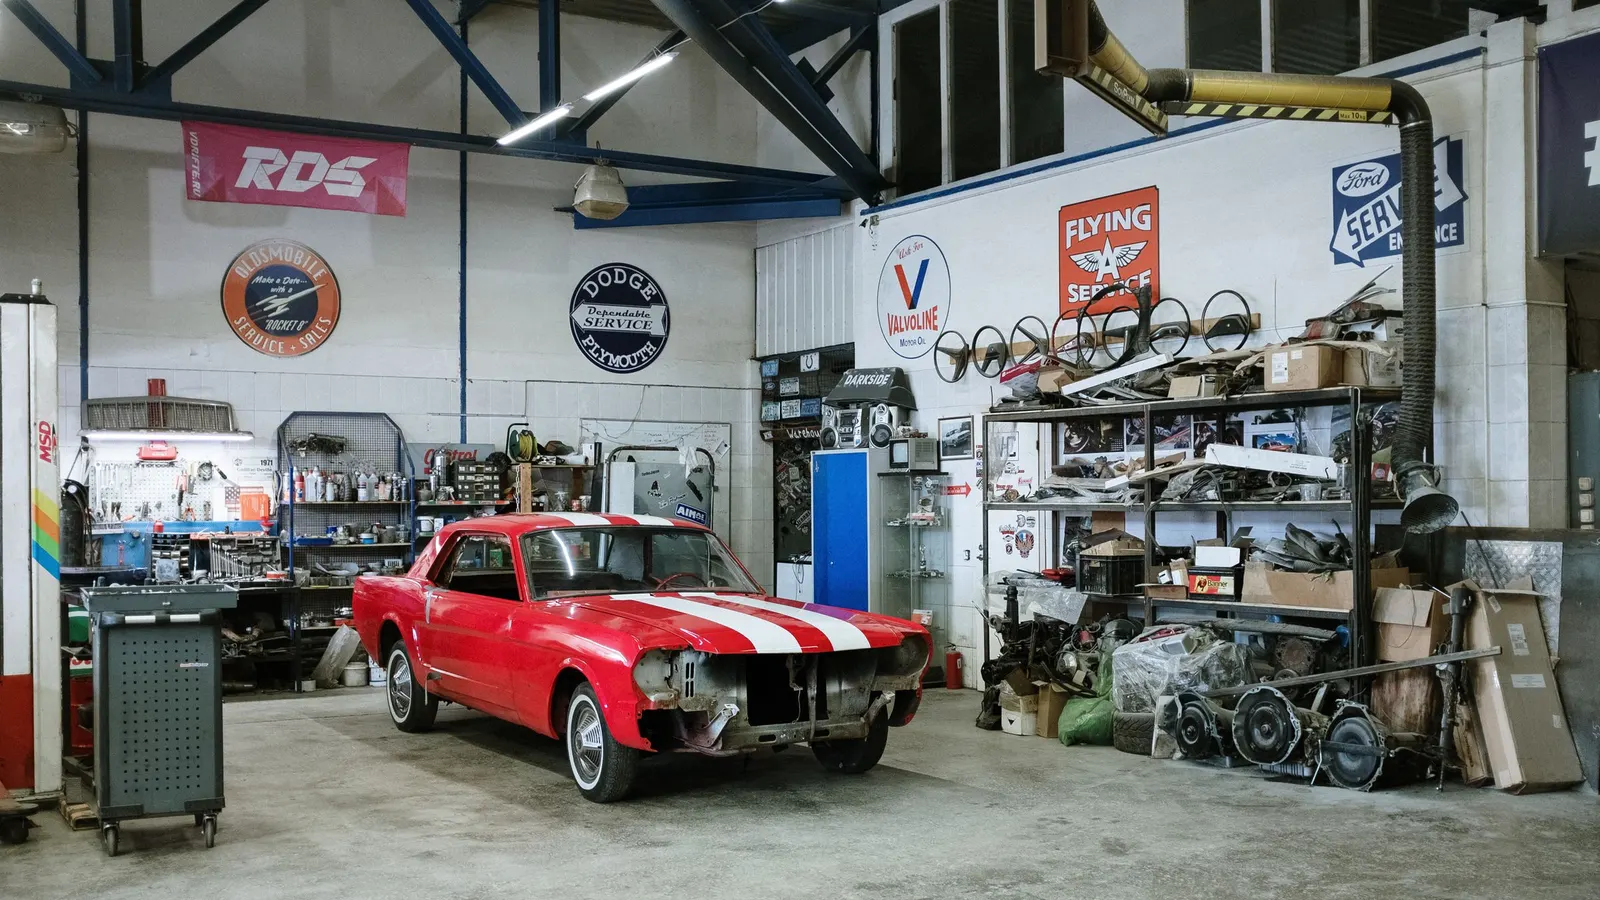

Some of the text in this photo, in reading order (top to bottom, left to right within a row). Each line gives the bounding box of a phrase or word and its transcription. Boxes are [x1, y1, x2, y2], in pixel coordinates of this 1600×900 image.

[234, 146, 378, 198] RDS
[1342, 168, 1385, 192] Ford
[1347, 164, 1443, 250] SERV
[1065, 203, 1152, 250] FLYING
[1389, 223, 1458, 251] ENNCE
[234, 245, 328, 282] OLDSMOBILE
[251, 275, 275, 285] Make
[583, 268, 657, 301] DODGE
[583, 317, 653, 330] SERVICE
[587, 306, 652, 318] Dependable
[887, 305, 939, 336] VALVOLINE
[234, 316, 332, 354] SERVICE SALES
[582, 334, 657, 368] PLYMOUTH
[844, 374, 891, 386] DARKSIDE
[39, 420, 52, 464] MSD
[786, 427, 821, 439] Warehou
